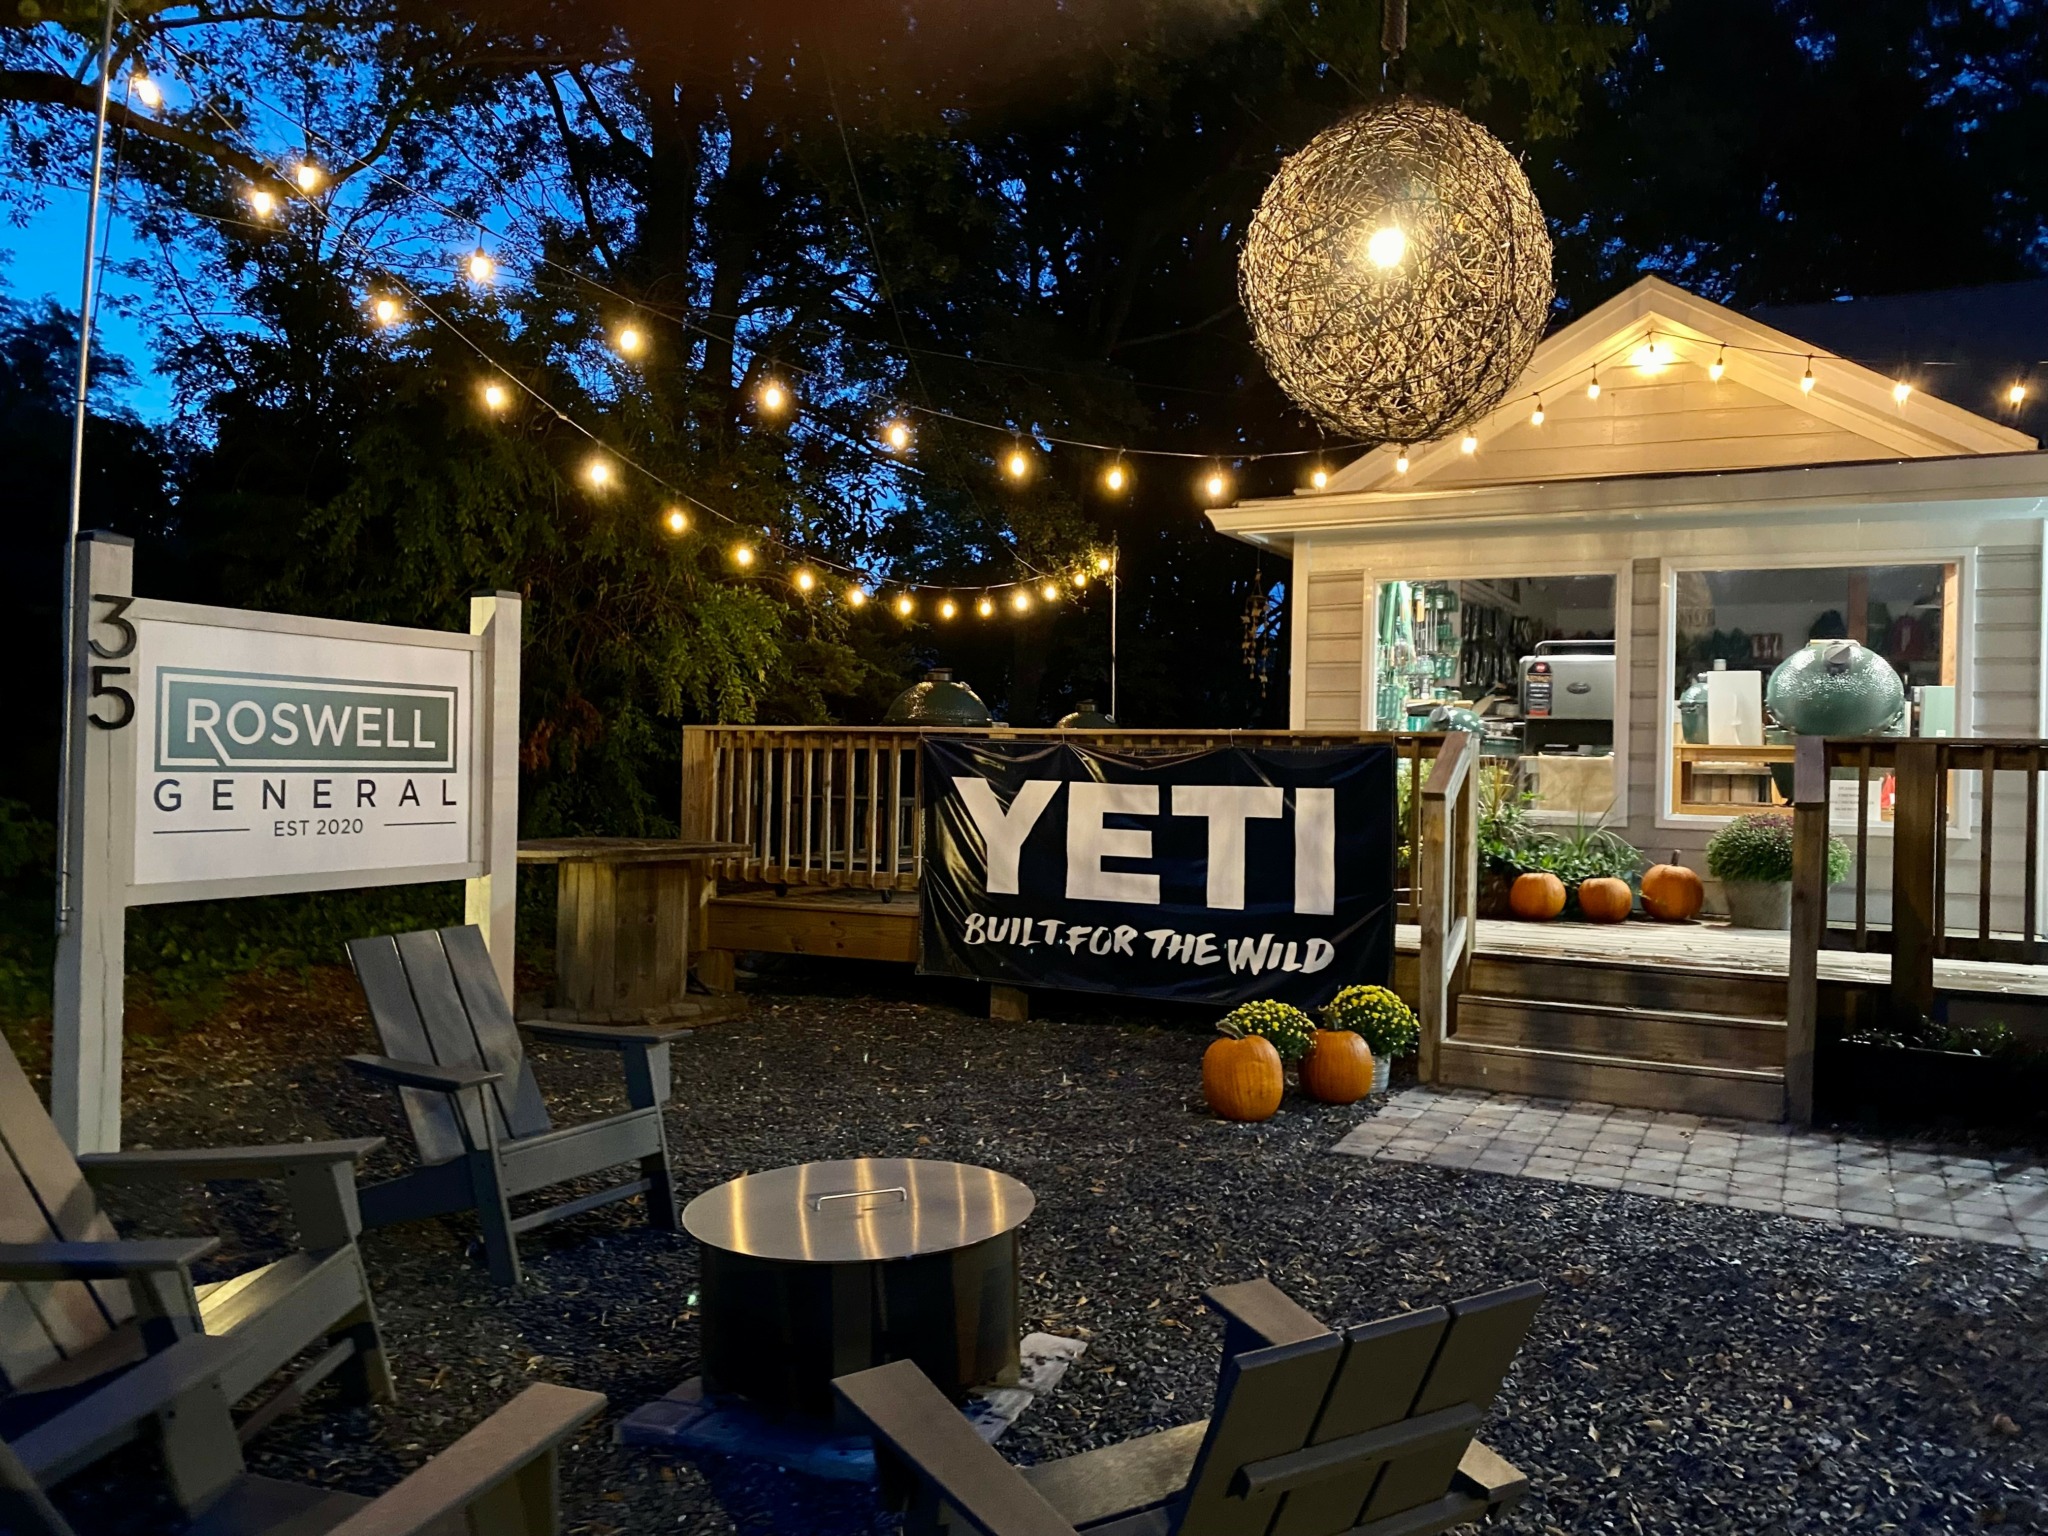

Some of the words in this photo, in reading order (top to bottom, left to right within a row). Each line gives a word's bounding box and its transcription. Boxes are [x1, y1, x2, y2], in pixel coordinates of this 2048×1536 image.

[88, 594, 137, 731] 35
[186, 698, 436, 766] ROSWELL
[153, 778, 458, 812] GENERAL
[273, 820, 310, 837] EST
[316, 818, 364, 835] 2020
[951, 776, 1336, 916] YETI
[963, 912, 1066, 947] BUILT
[1065, 924, 1138, 957] FOR
[1144, 928, 1222, 966] THE
[1227, 933, 1335, 976] WILD
